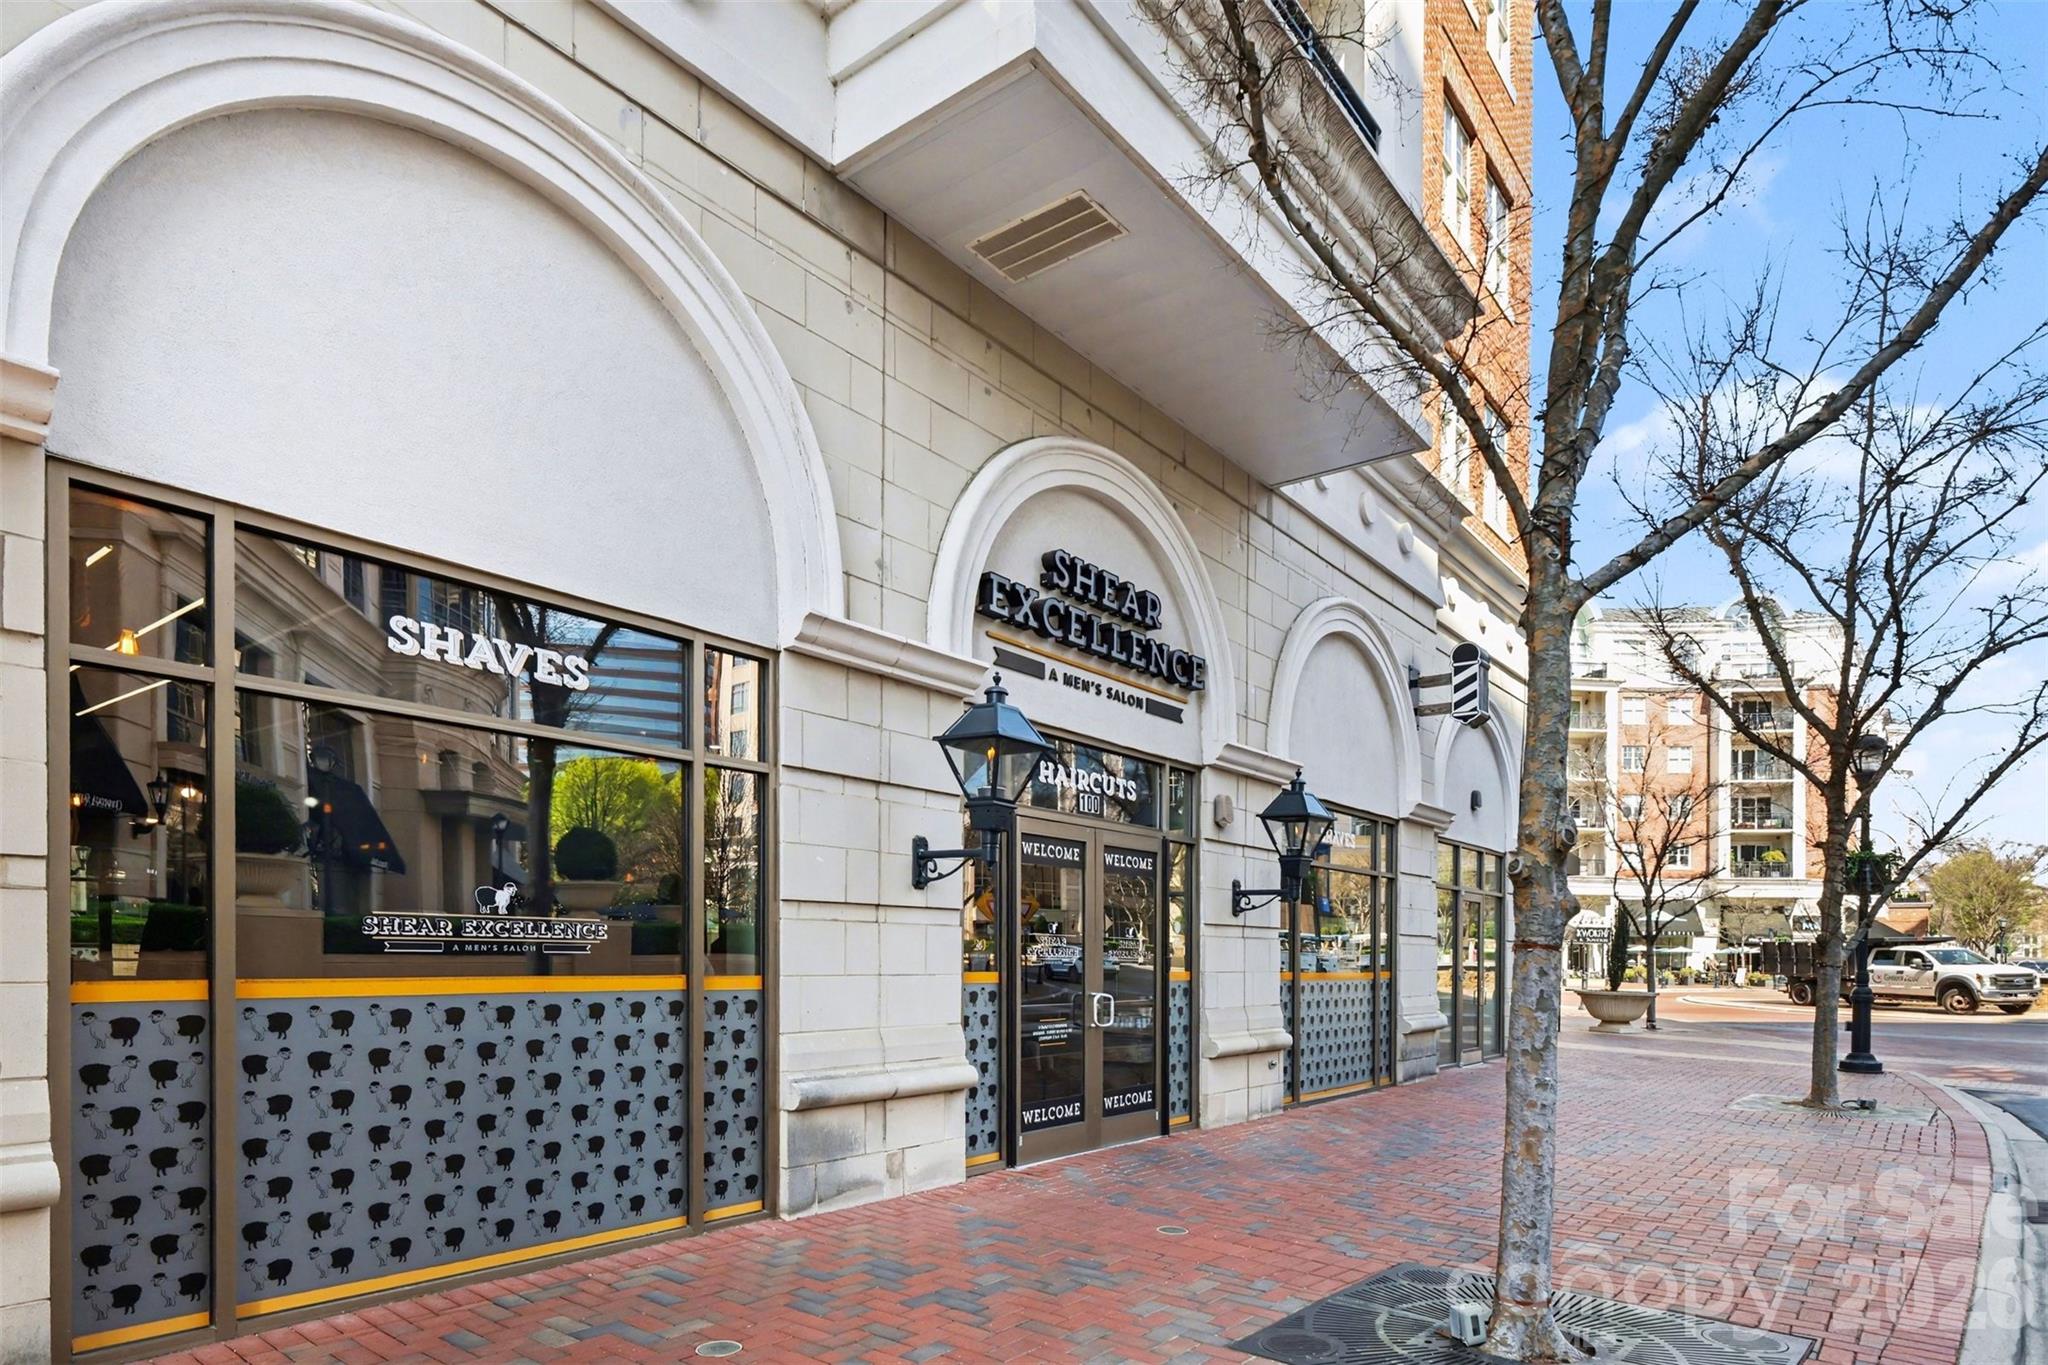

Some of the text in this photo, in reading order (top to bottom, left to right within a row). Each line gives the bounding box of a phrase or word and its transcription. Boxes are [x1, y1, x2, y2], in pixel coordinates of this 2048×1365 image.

[1040, 549, 1162, 629] SHEAR
[977, 571, 1205, 691] EXCELLENCE
[387, 614, 590, 692] SHAVES
[1048, 667, 1144, 710] A MEN'S SALON
[1038, 760, 1137, 803] HAIRCUTS
[1080, 795, 1100, 814] 100
[1021, 841, 1081, 861] WELCOME
[1104, 853, 1153, 871] WELCOME
[362, 915, 608, 940] SHEAR EXCELLENCE
[452, 944, 537, 953] A MEN'S SALON
[1103, 1089, 1153, 1110] WELCOME
[1022, 1102, 1081, 1125] WELCOME
